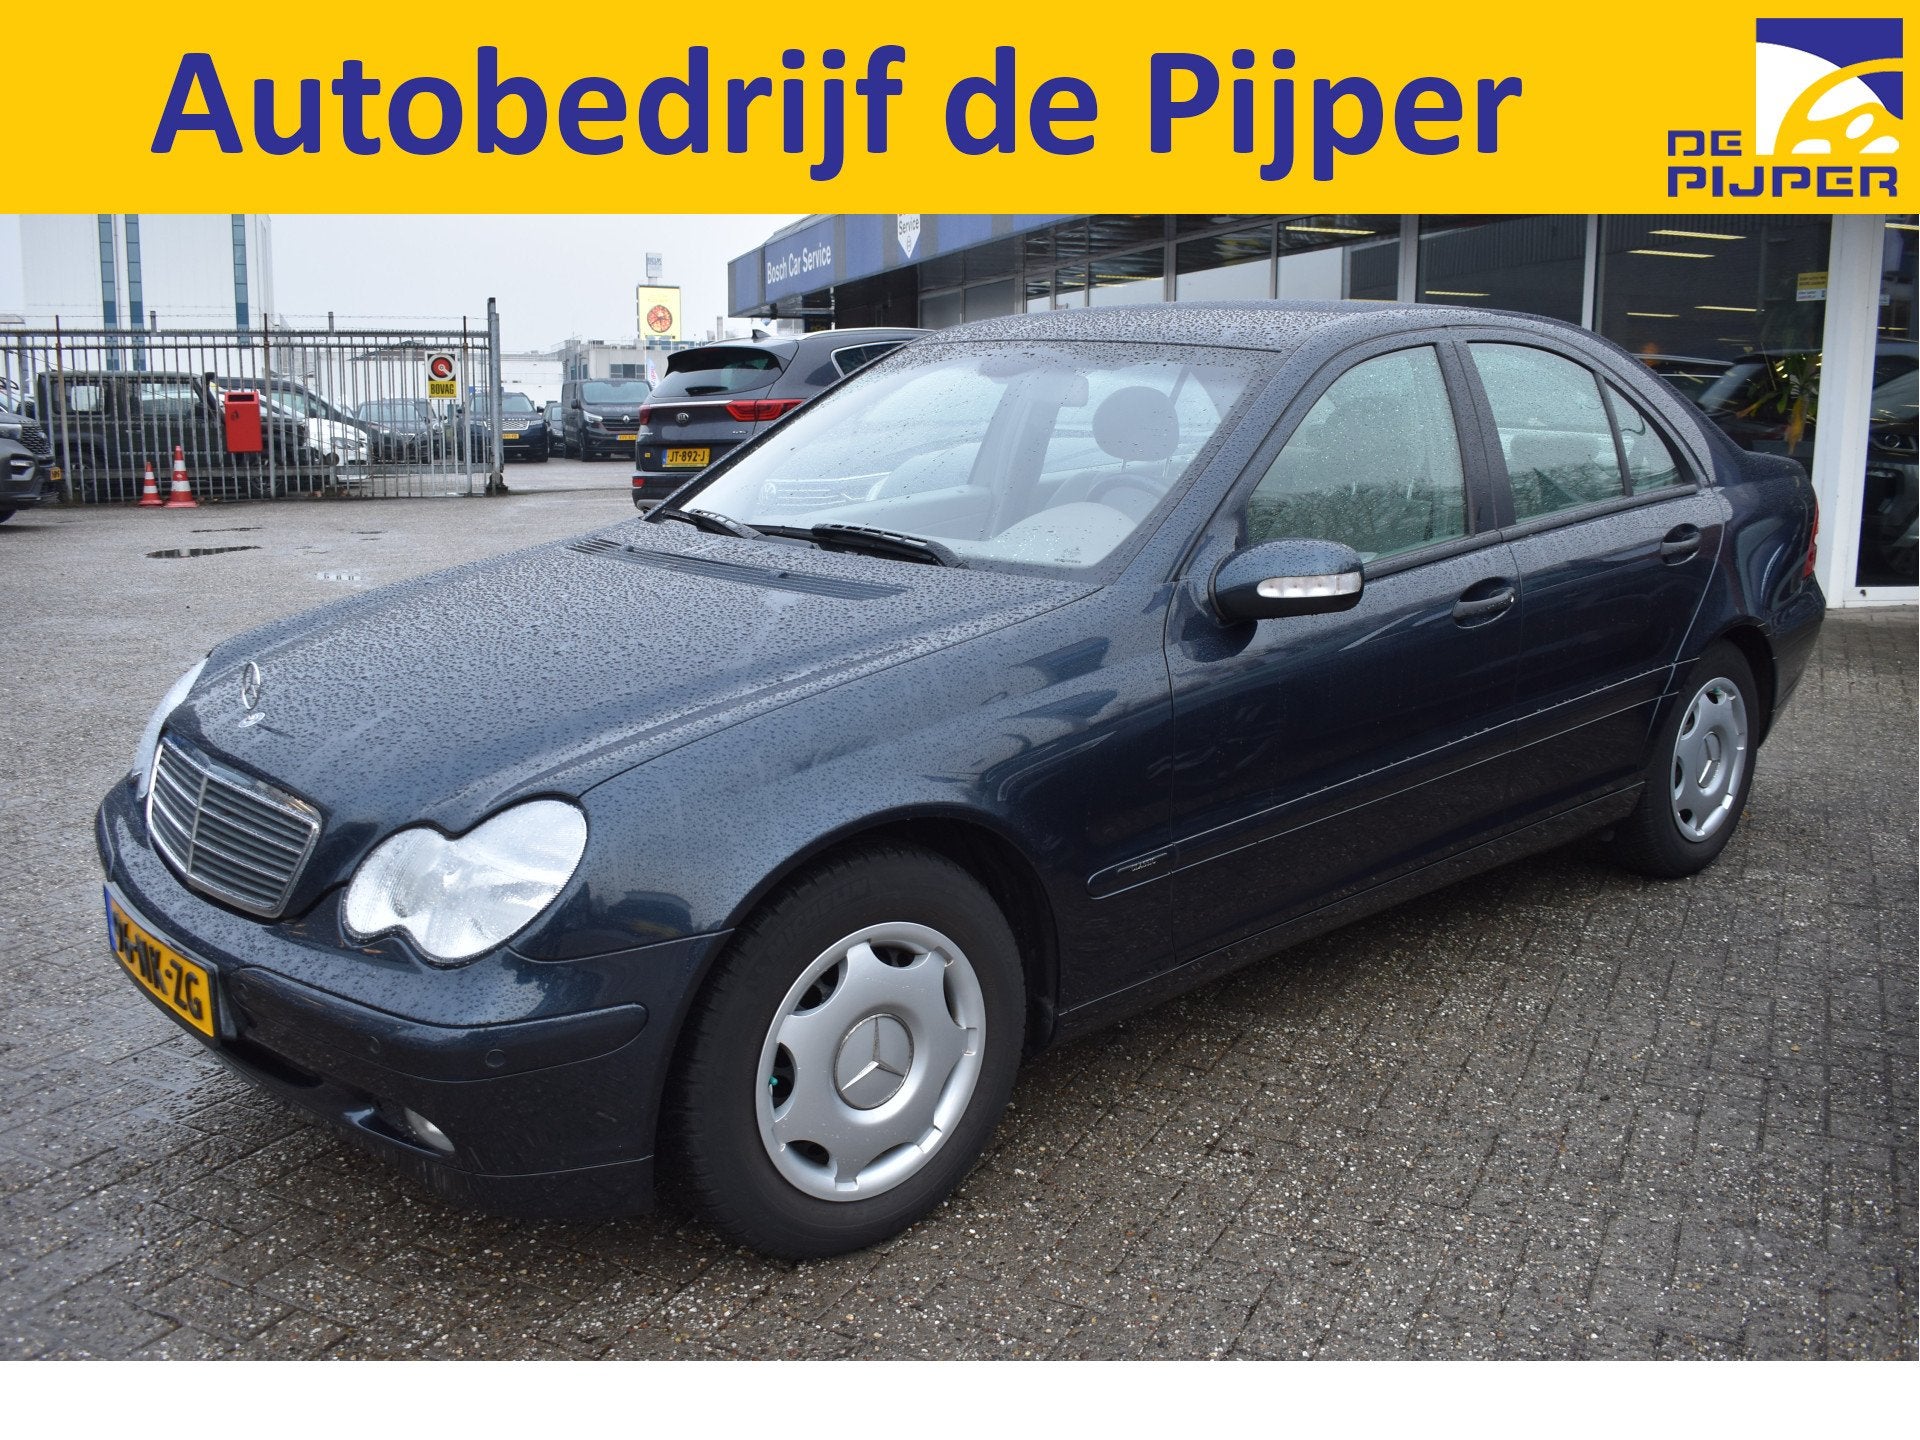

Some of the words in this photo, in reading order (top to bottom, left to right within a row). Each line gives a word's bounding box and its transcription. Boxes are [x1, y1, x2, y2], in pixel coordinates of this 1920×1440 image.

[898, 218, 920, 236] Service
[767, 256, 788, 285] Bosch
[788, 252, 801, 277] Car
[802, 242, 832, 273] Service
[430, 383, 455, 395] BOVAG
[669, 450, 706, 462] JT-892-J
